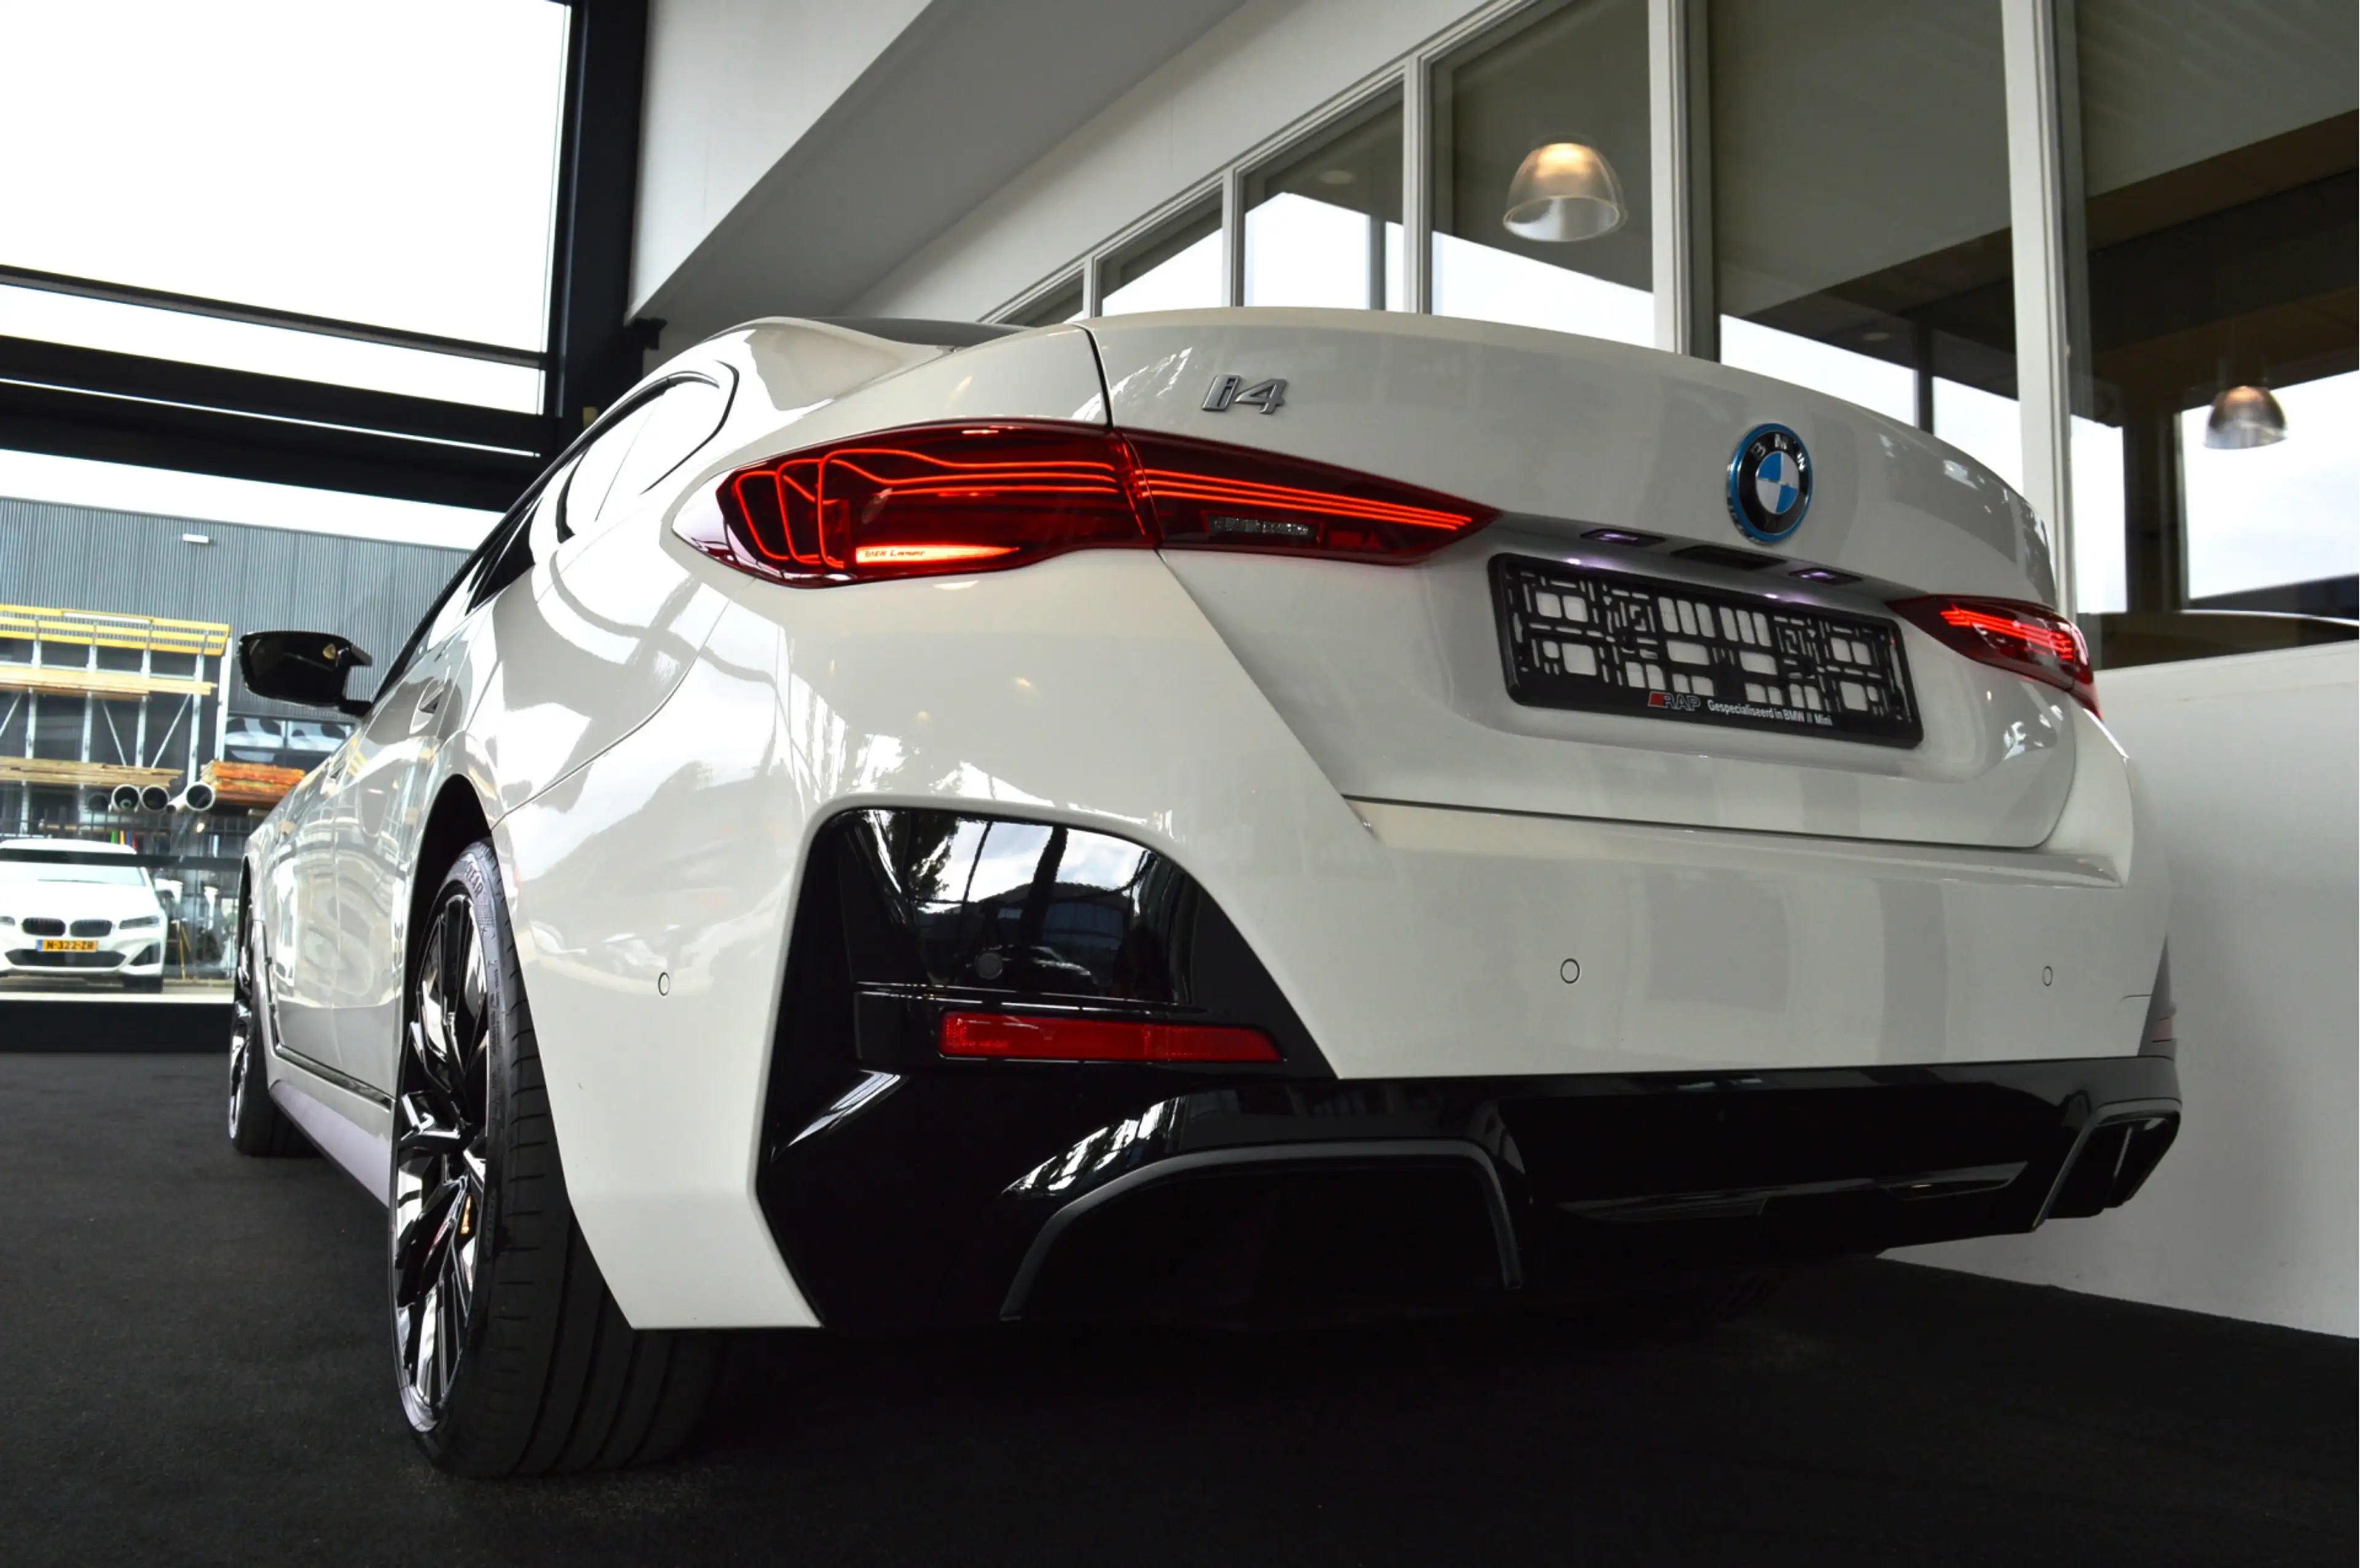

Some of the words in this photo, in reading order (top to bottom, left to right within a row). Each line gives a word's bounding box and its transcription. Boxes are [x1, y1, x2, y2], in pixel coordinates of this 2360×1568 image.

[1202, 375, 1288, 414] i4
[1752, 433, 1806, 472] BMW
[1664, 691, 1701, 711] RAP
[1707, 699, 1774, 719] Gespecialiseerd
[1774, 708, 1782, 719] in
[1783, 709, 1805, 722] BMW
